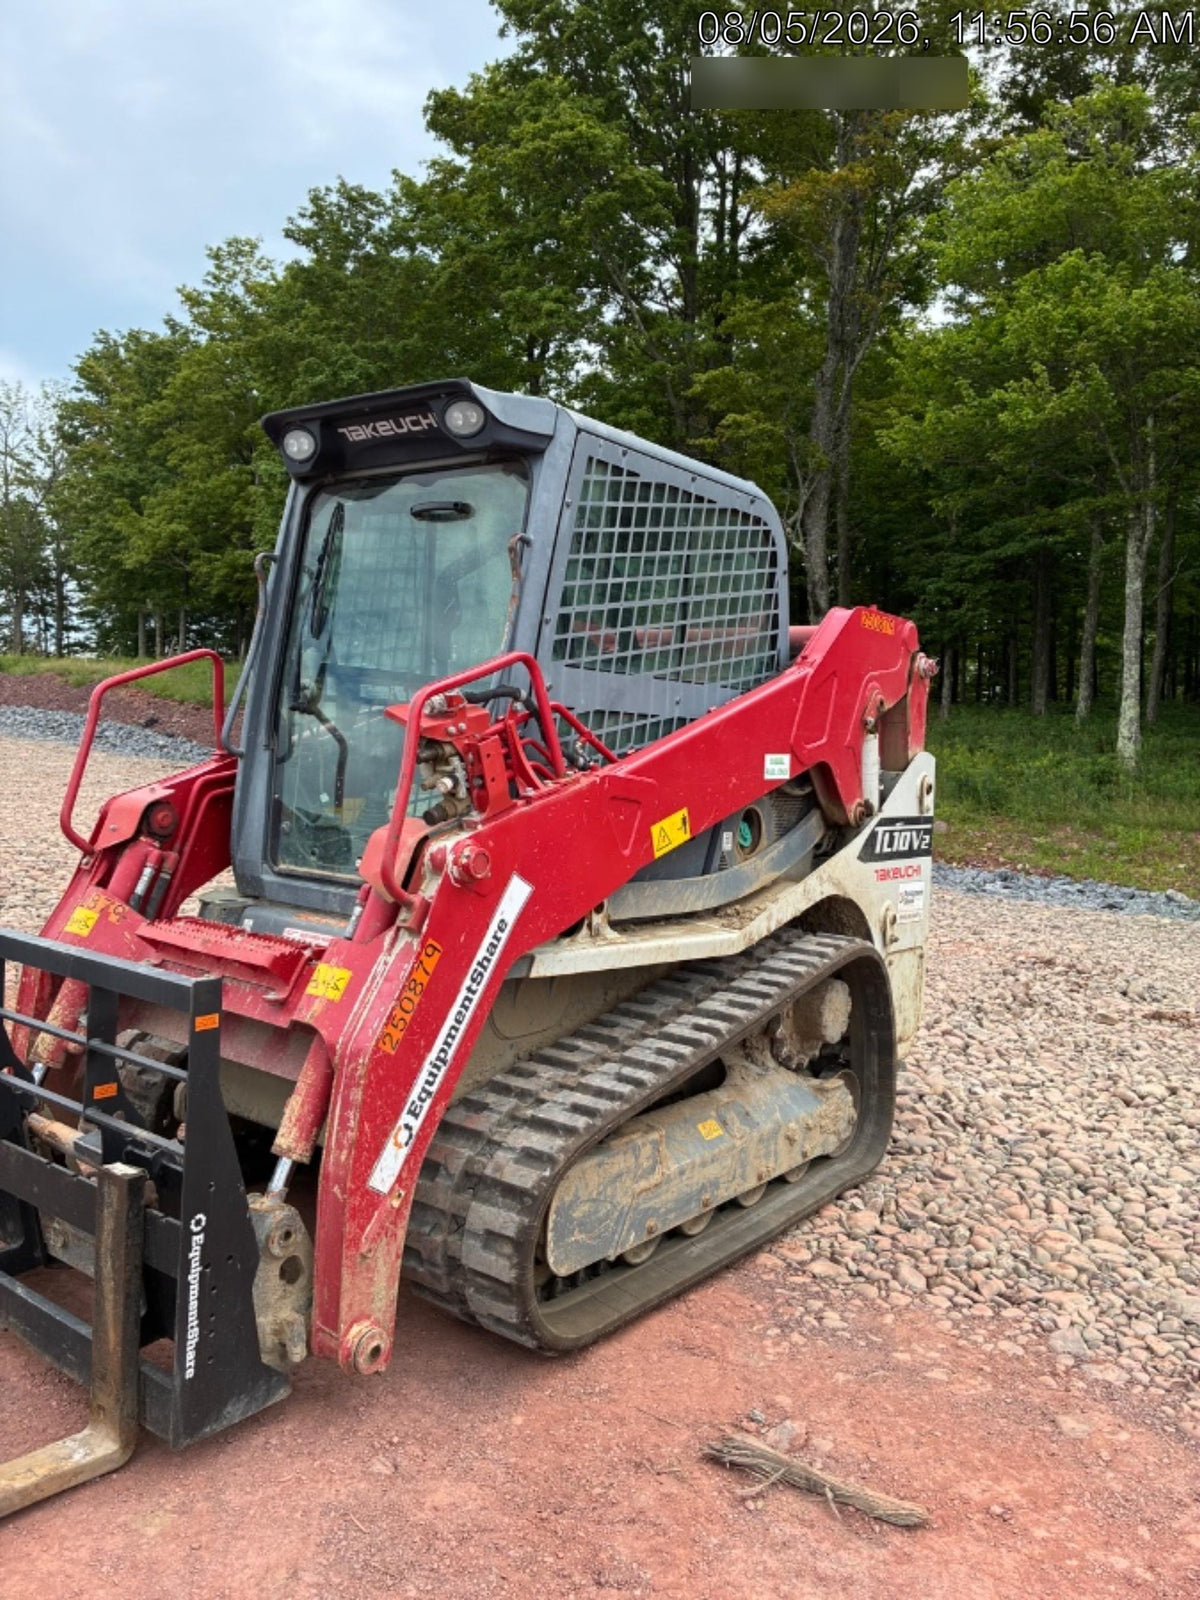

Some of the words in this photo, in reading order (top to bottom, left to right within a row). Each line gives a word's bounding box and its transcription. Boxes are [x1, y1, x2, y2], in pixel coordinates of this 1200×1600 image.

[381, 943, 442, 1051] 250879
[406, 917, 509, 1122] EquipmentShare
[184, 1232, 205, 1381] EquipmentShare
